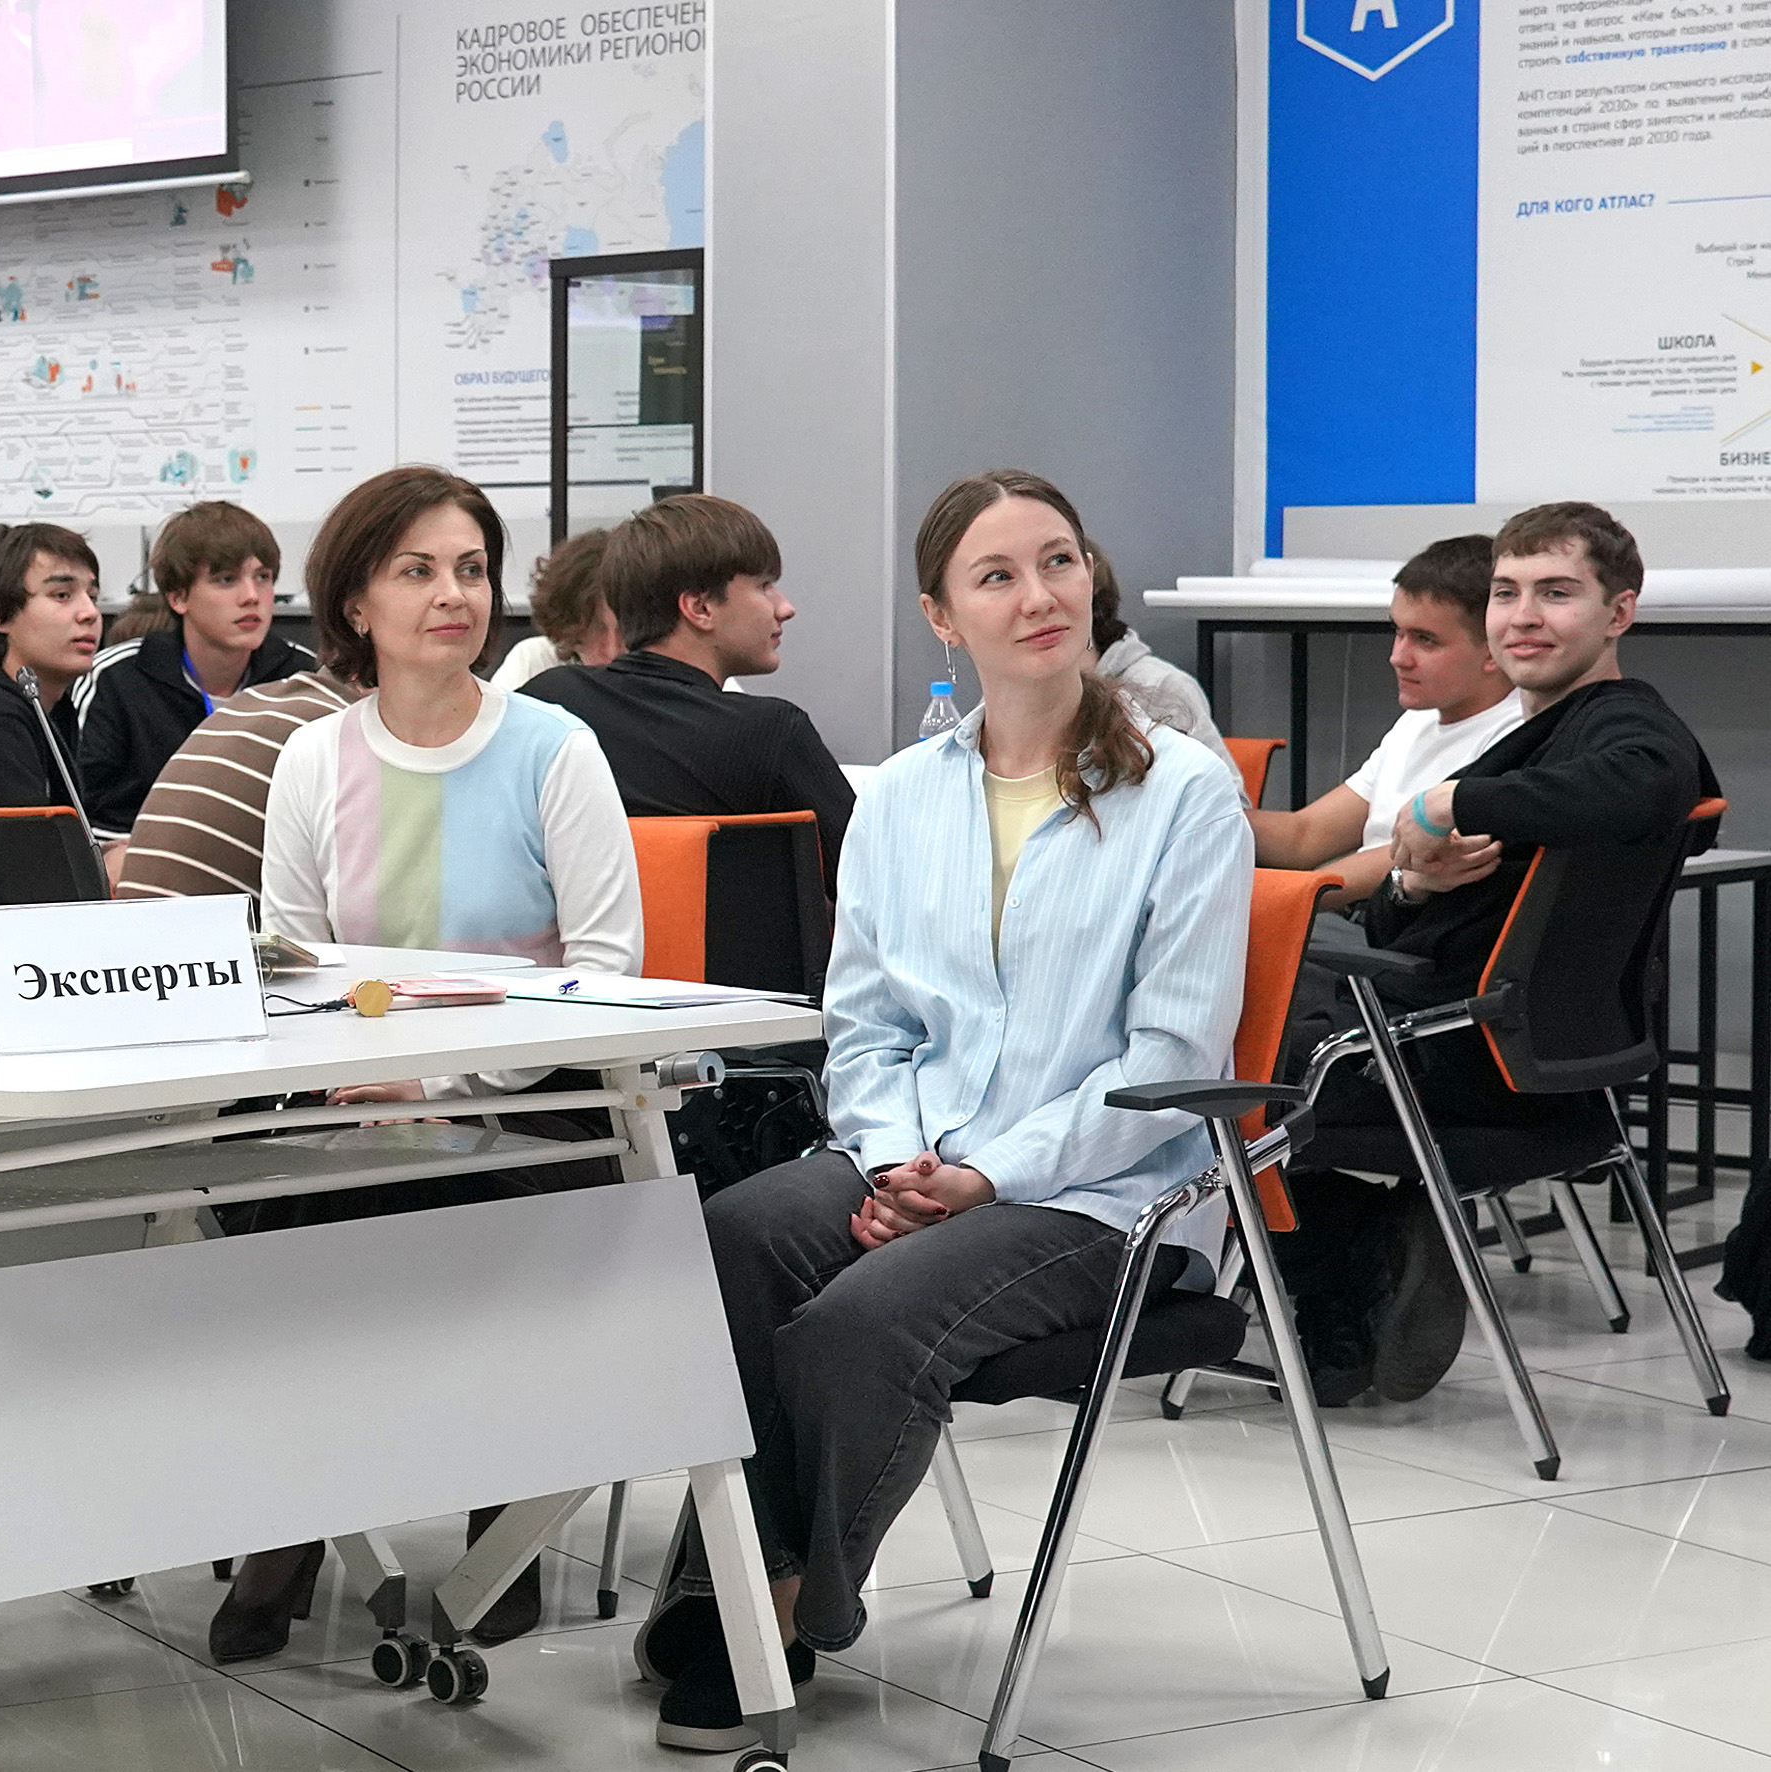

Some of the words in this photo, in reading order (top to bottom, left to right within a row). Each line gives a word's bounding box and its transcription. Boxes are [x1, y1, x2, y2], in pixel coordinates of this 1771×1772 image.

[456, 18, 566, 50] КАДРОВОЕ
[581, 2, 705, 37] ОБЕСПЕЧЕН
[1584, 16, 1624, 28] вопрос
[456, 42, 590, 77] ЭКОНОМИКИ
[599, 28, 705, 61] РЕГИОНО
[1518, 57, 1561, 68] строить
[1565, 50, 1645, 64] собственную
[1651, 41, 1727, 56] траекторию
[456, 74, 541, 103] РОССИИ
[1575, 84, 1646, 99] результатом
[1650, 77, 1717, 91] системного
[1517, 102, 1592, 119] компетенций
[1572, 121, 1611, 133] стране
[1647, 130, 1679, 144] 2030
[1516, 201, 1549, 218] ДЛЯ
[1555, 198, 1594, 213] КОГО
[1599, 193, 1655, 210] АТЛАС?
[1658, 334, 1716, 350] ШКОЛА
[454, 371, 490, 386] ОБРАЗ
[492, 369, 550, 385] БУДУЩЕГО
[1719, 451, 1771, 467] БИЗНЕ
[14, 959, 242, 1001] Эксперты
